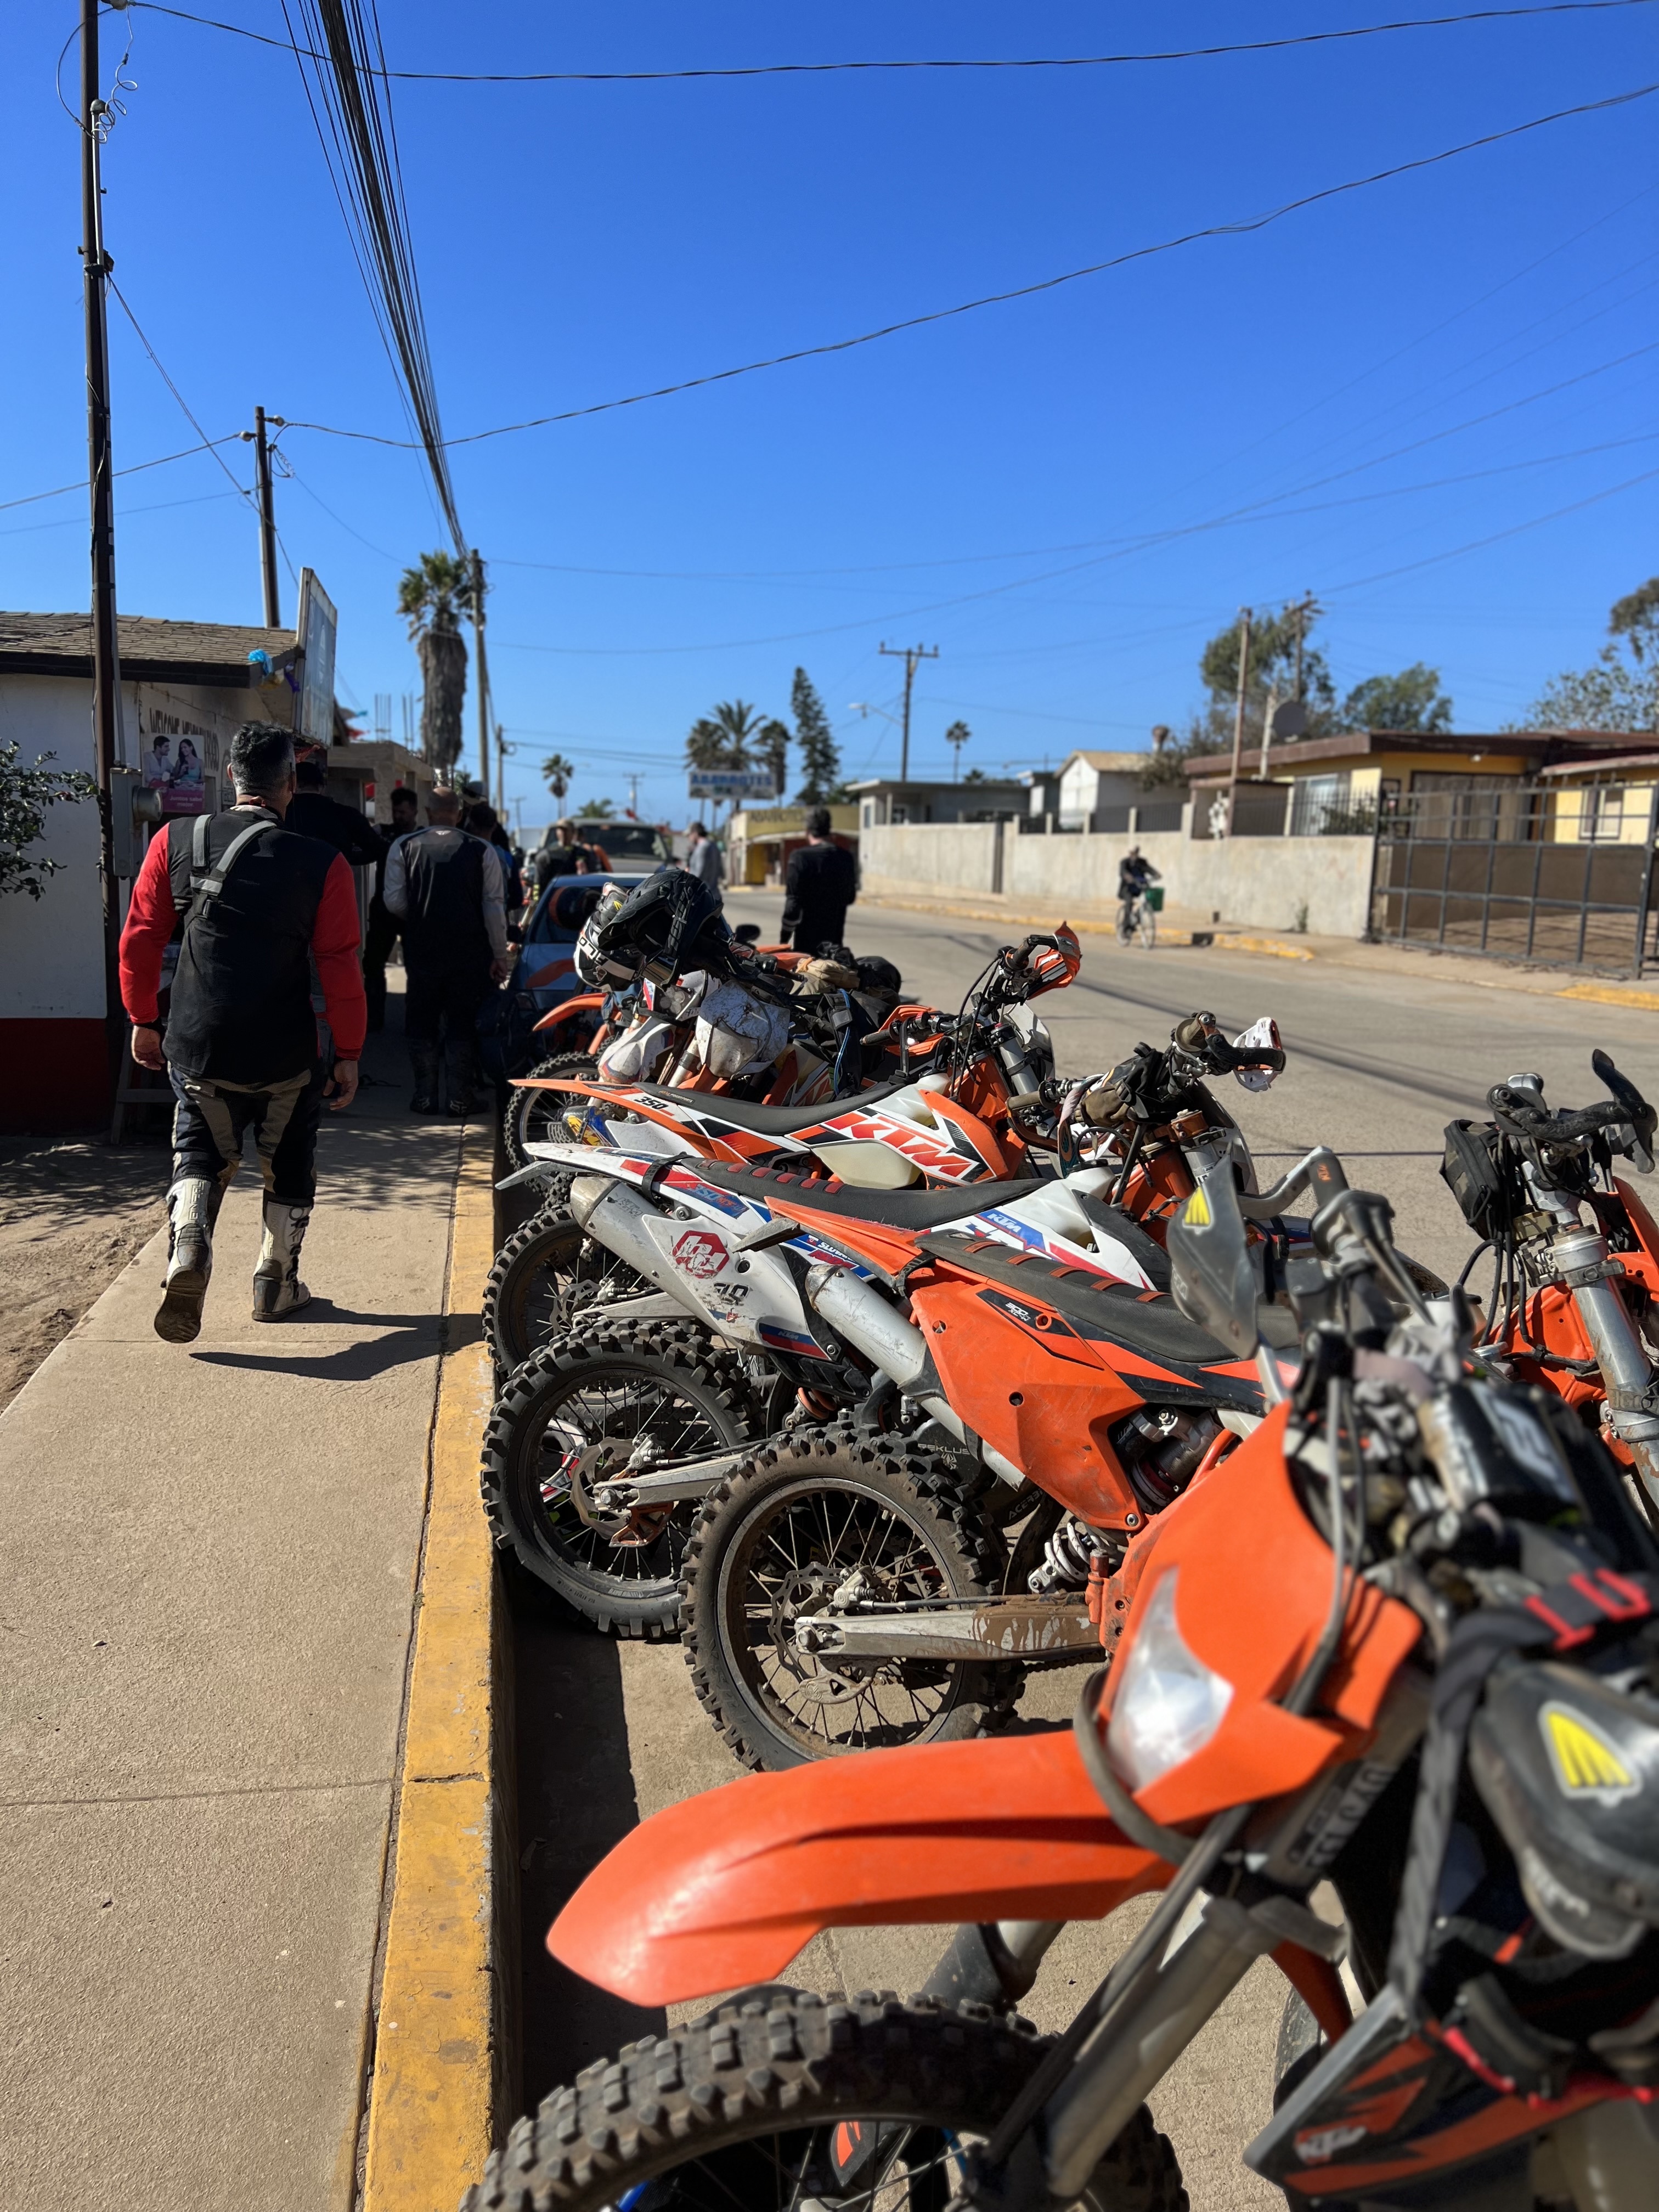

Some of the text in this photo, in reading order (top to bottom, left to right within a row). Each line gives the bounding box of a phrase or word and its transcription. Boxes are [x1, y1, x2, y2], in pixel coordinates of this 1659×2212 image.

[634, 1096, 669, 1109] 350
[823, 1111, 973, 1179] KTM
[987, 1213, 1022, 1233] KTM
[1005, 1302, 1029, 1316] 300
[777, 1330, 799, 1340] KTM
[917, 1443, 970, 1455] REKLUS
